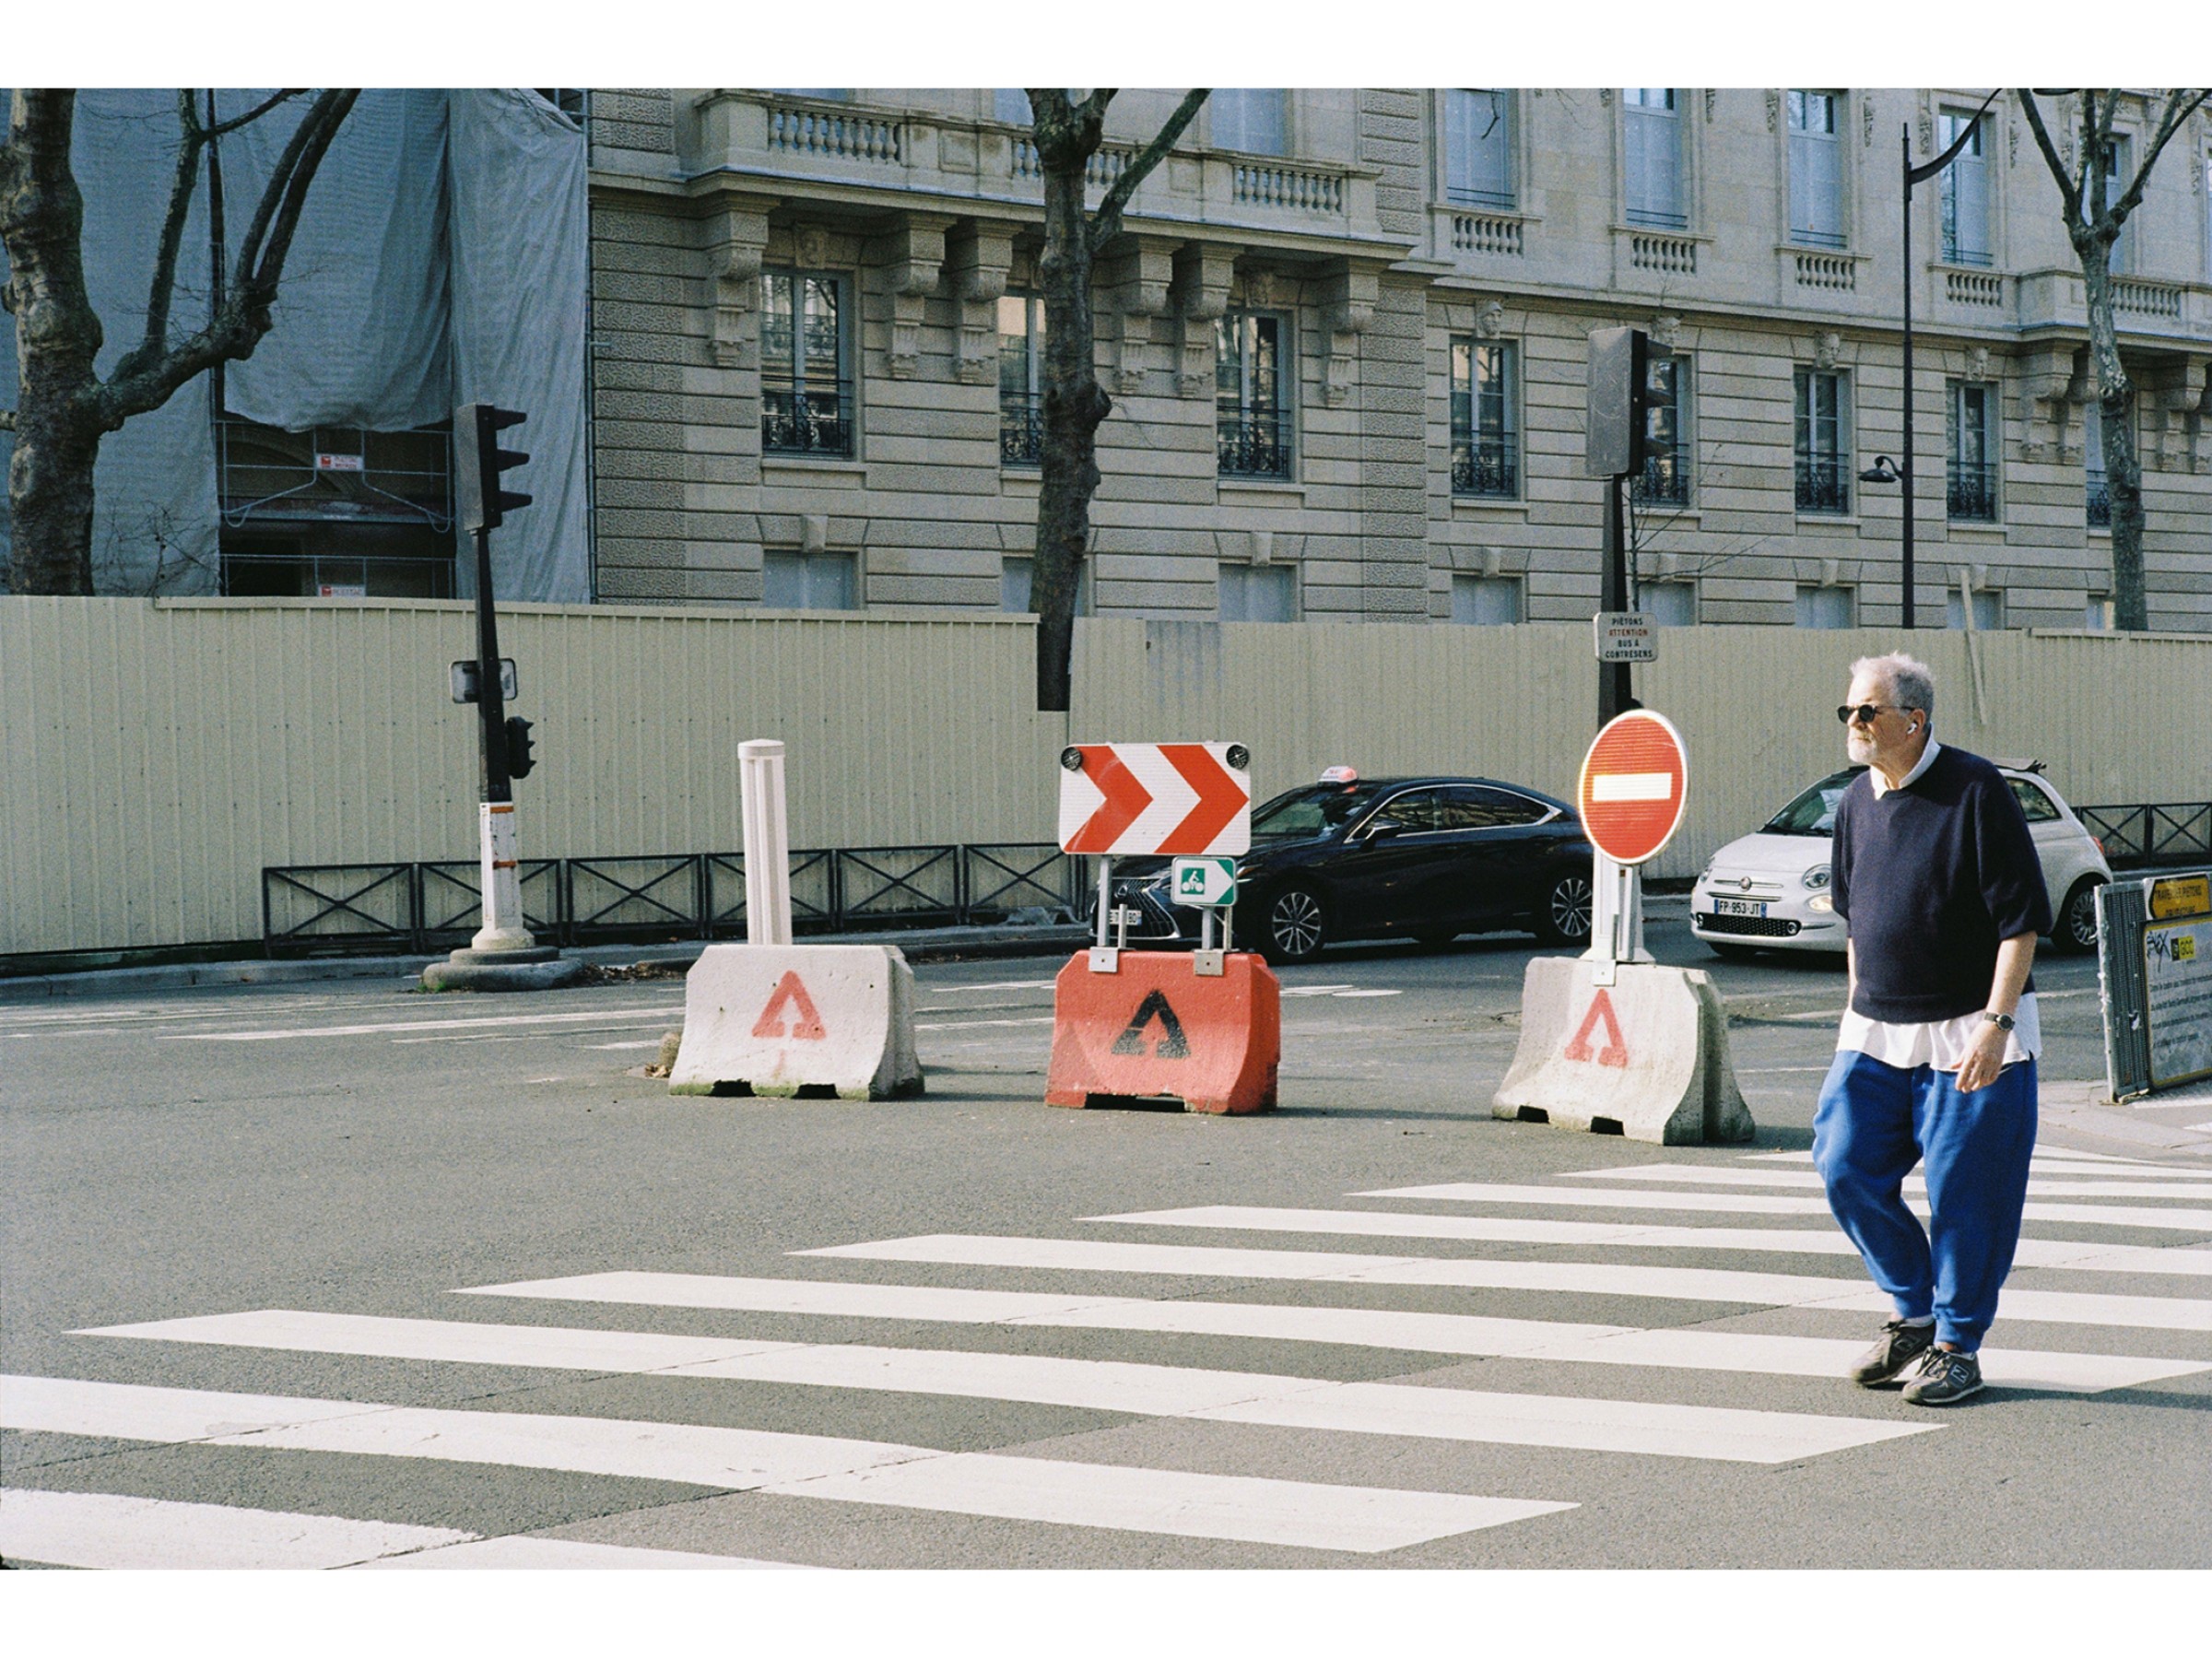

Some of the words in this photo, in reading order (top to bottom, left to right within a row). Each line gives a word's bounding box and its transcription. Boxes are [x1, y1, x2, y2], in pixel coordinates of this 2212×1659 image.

[1608, 629, 1648, 637] ATTENTION
[1606, 650, 1653, 658] CONTRESENS
[1719, 900, 1759, 914] FP-953-JT
[1950, 1364, 1969, 1383] N
